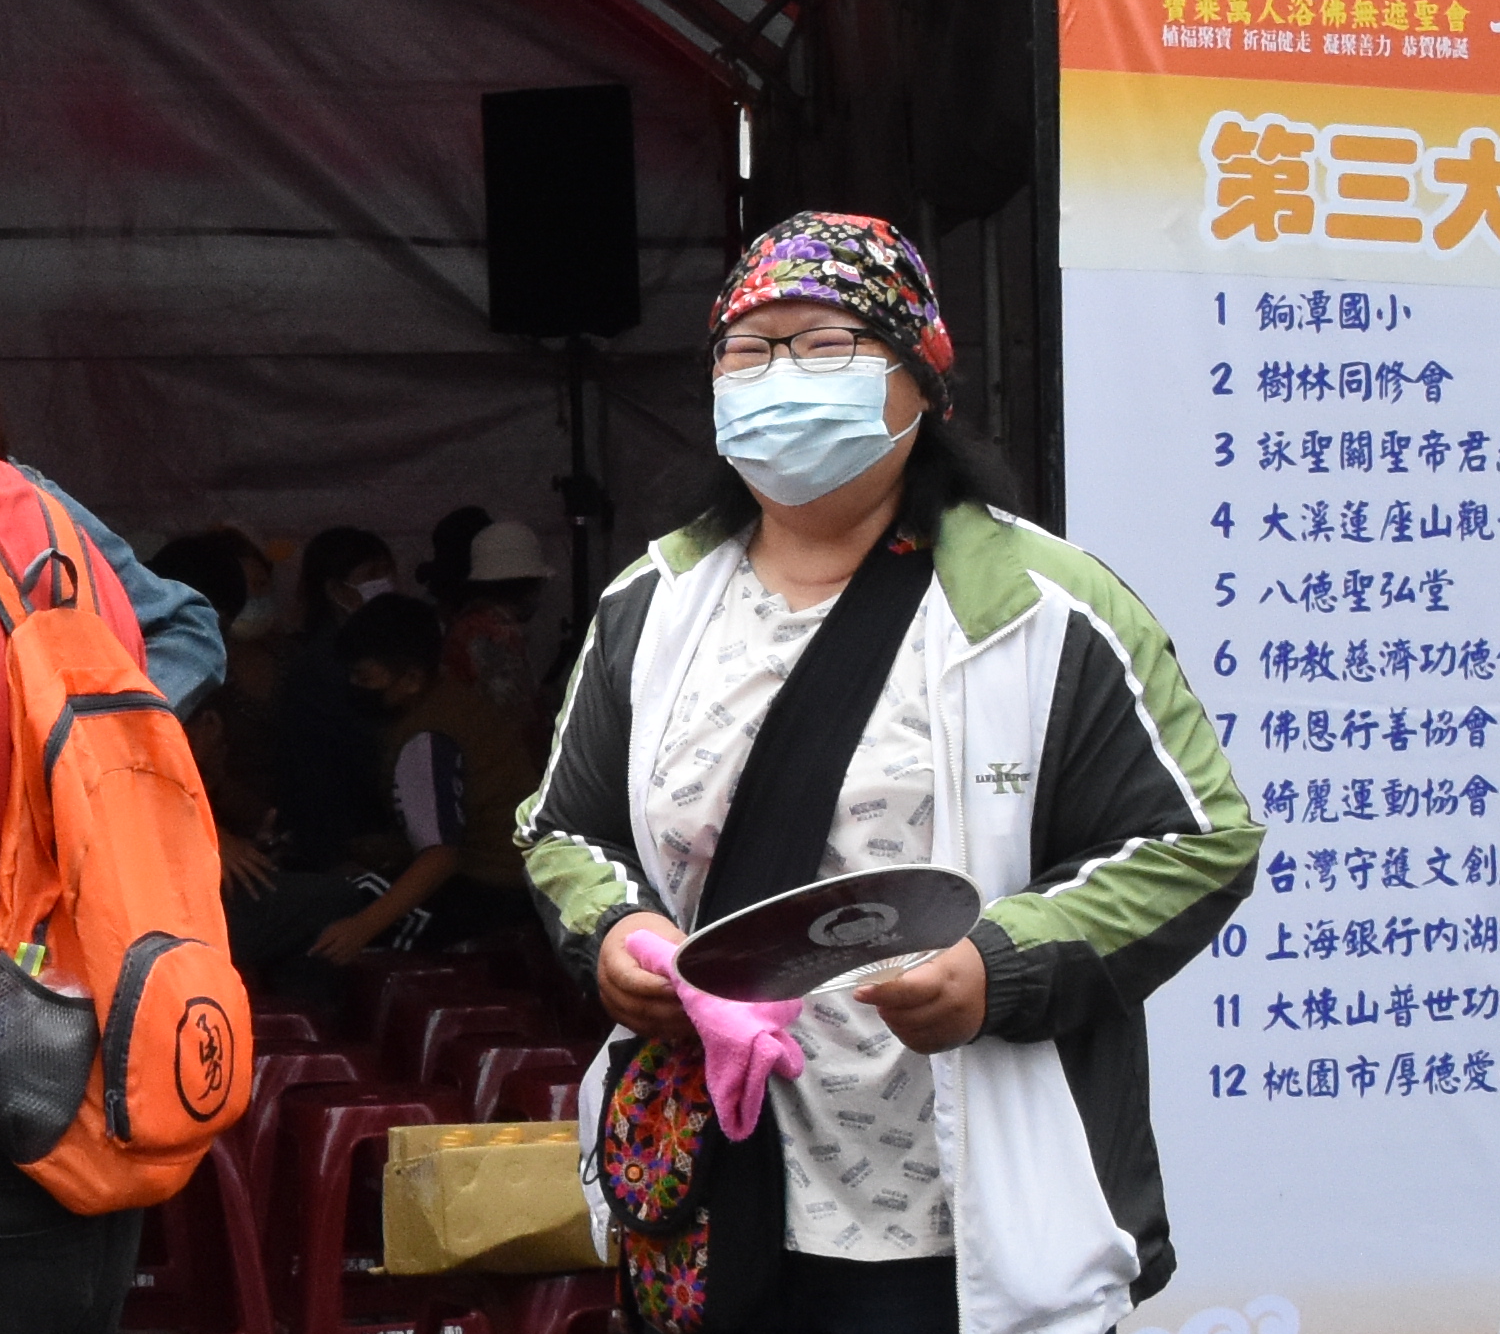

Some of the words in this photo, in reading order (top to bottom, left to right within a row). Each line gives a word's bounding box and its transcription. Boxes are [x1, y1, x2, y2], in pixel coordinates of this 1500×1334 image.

[1214, 291, 1226, 326] 1
[1255, 289, 1412, 334] 餉潭國小
[1209, 362, 1234, 396] 2
[1257, 360, 1454, 404] 樹林同修會
[1214, 432, 1235, 467] 3
[1210, 501, 1236, 539] 4
[1214, 572, 1236, 608] 5
[1259, 568, 1454, 614] 八德聖弘堂
[1213, 639, 1238, 677] 6
[1215, 712, 1238, 748] 7
[1260, 705, 1498, 753] 佛恩行善協會
[1262, 774, 1499, 824] 綺麗運動協會
[1211, 923, 1248, 959] 10
[1213, 993, 1240, 1028] 11
[1209, 1063, 1248, 1099] 12
